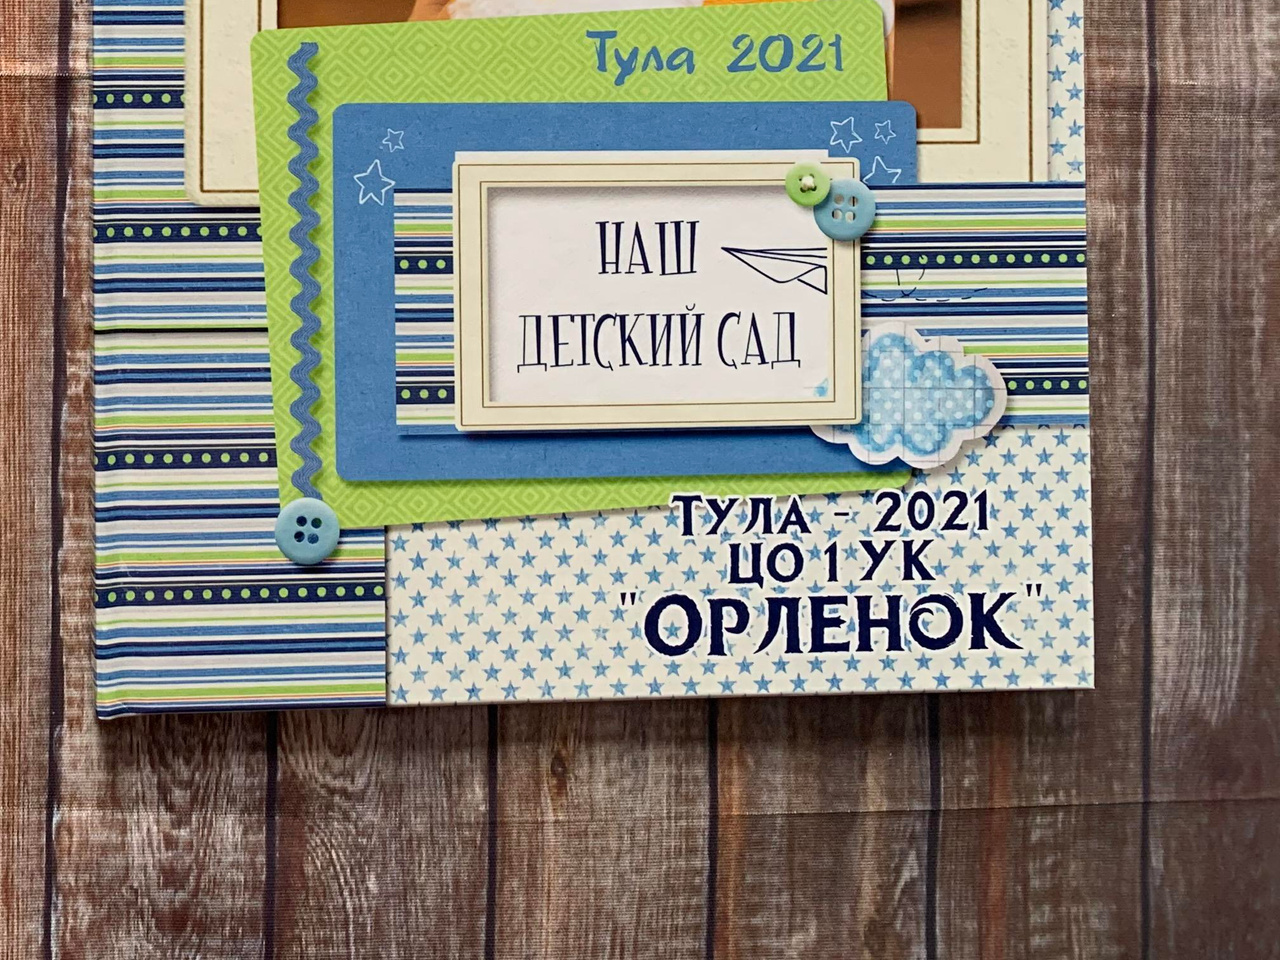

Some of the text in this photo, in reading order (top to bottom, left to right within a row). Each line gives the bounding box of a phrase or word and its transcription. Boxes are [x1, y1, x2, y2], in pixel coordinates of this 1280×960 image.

[586, 29, 845, 86] Тула 2021
[597, 221, 700, 277] НАШ
[517, 304, 801, 374] ДЕТСКИЙ САД
[671, 493, 810, 537] ТУЛА
[874, 489, 991, 532] 2021
[728, 539, 936, 588] ЦО 1 УК
[619, 582, 1043, 657] "ОРЛЕНОК"
